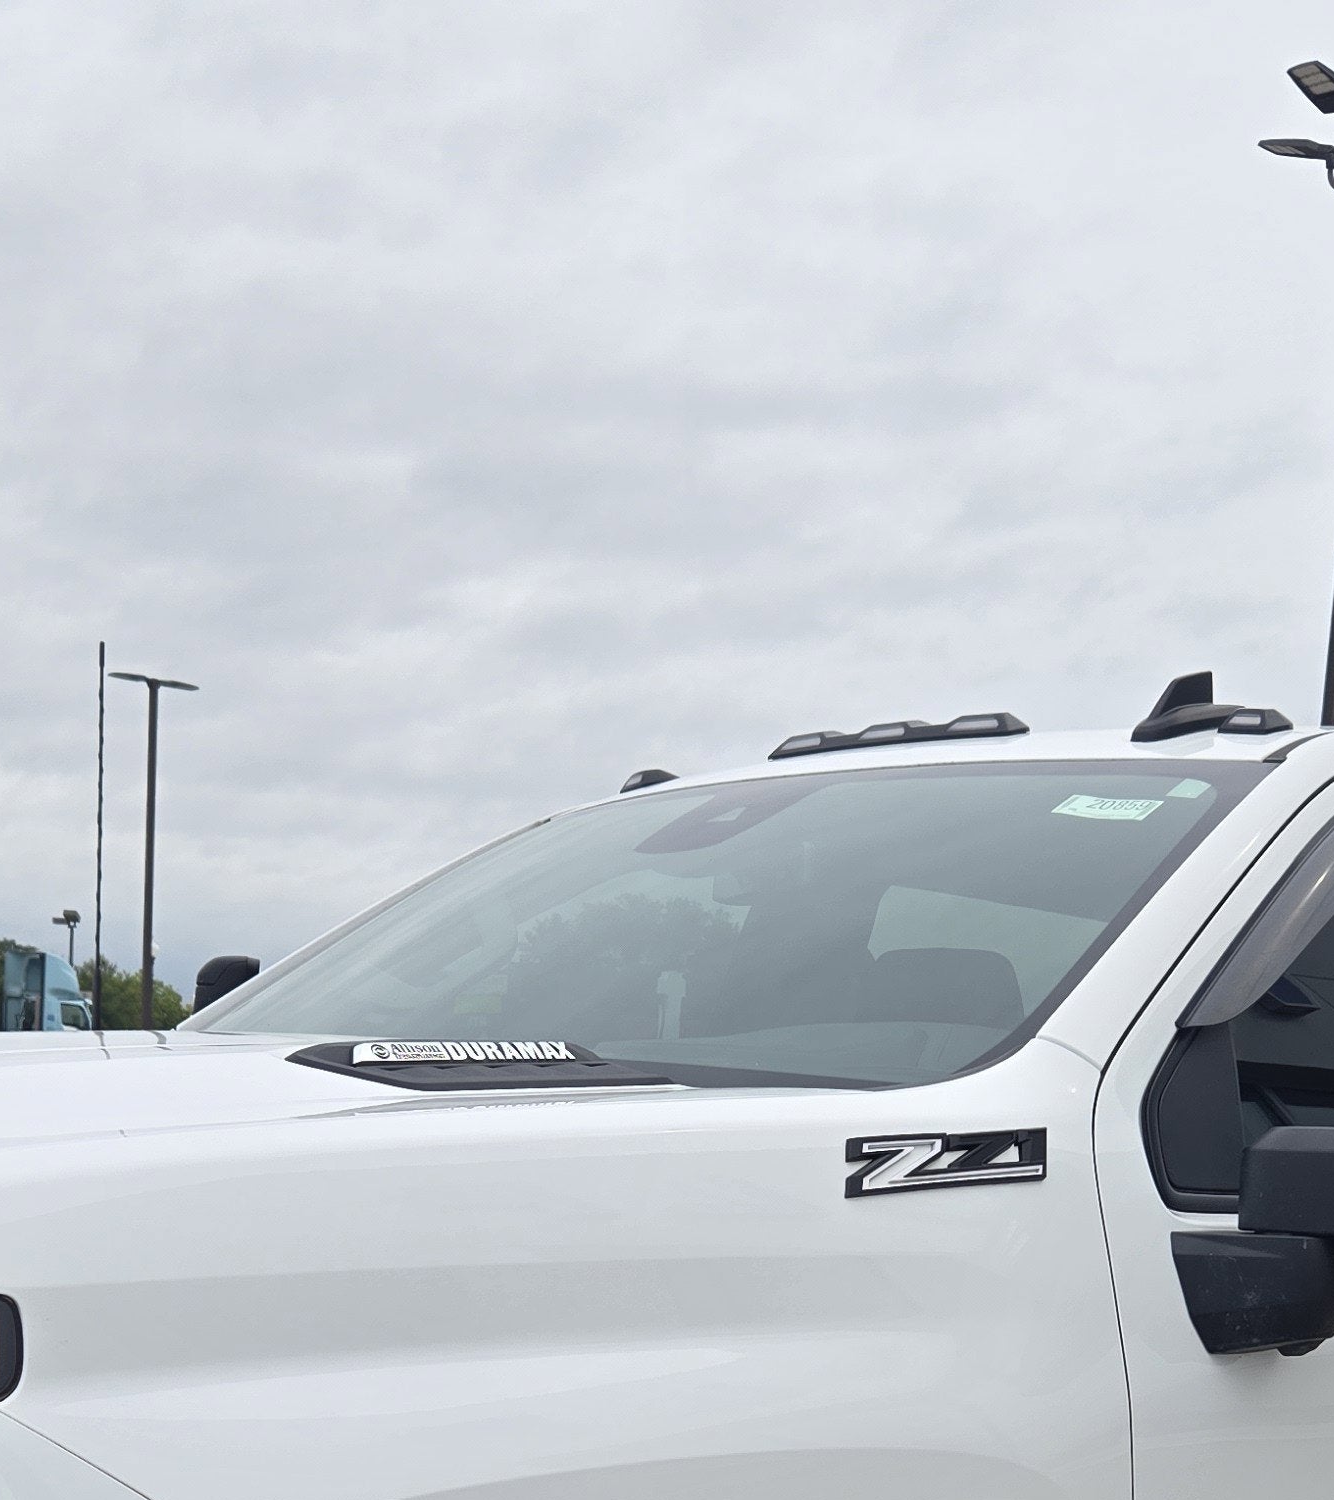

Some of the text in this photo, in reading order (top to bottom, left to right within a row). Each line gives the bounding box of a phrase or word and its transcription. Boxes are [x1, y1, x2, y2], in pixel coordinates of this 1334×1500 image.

[1086, 799, 1153, 811] 20859
[391, 1043, 442, 1053] Allison
[446, 1041, 576, 1061] DURAMAX
